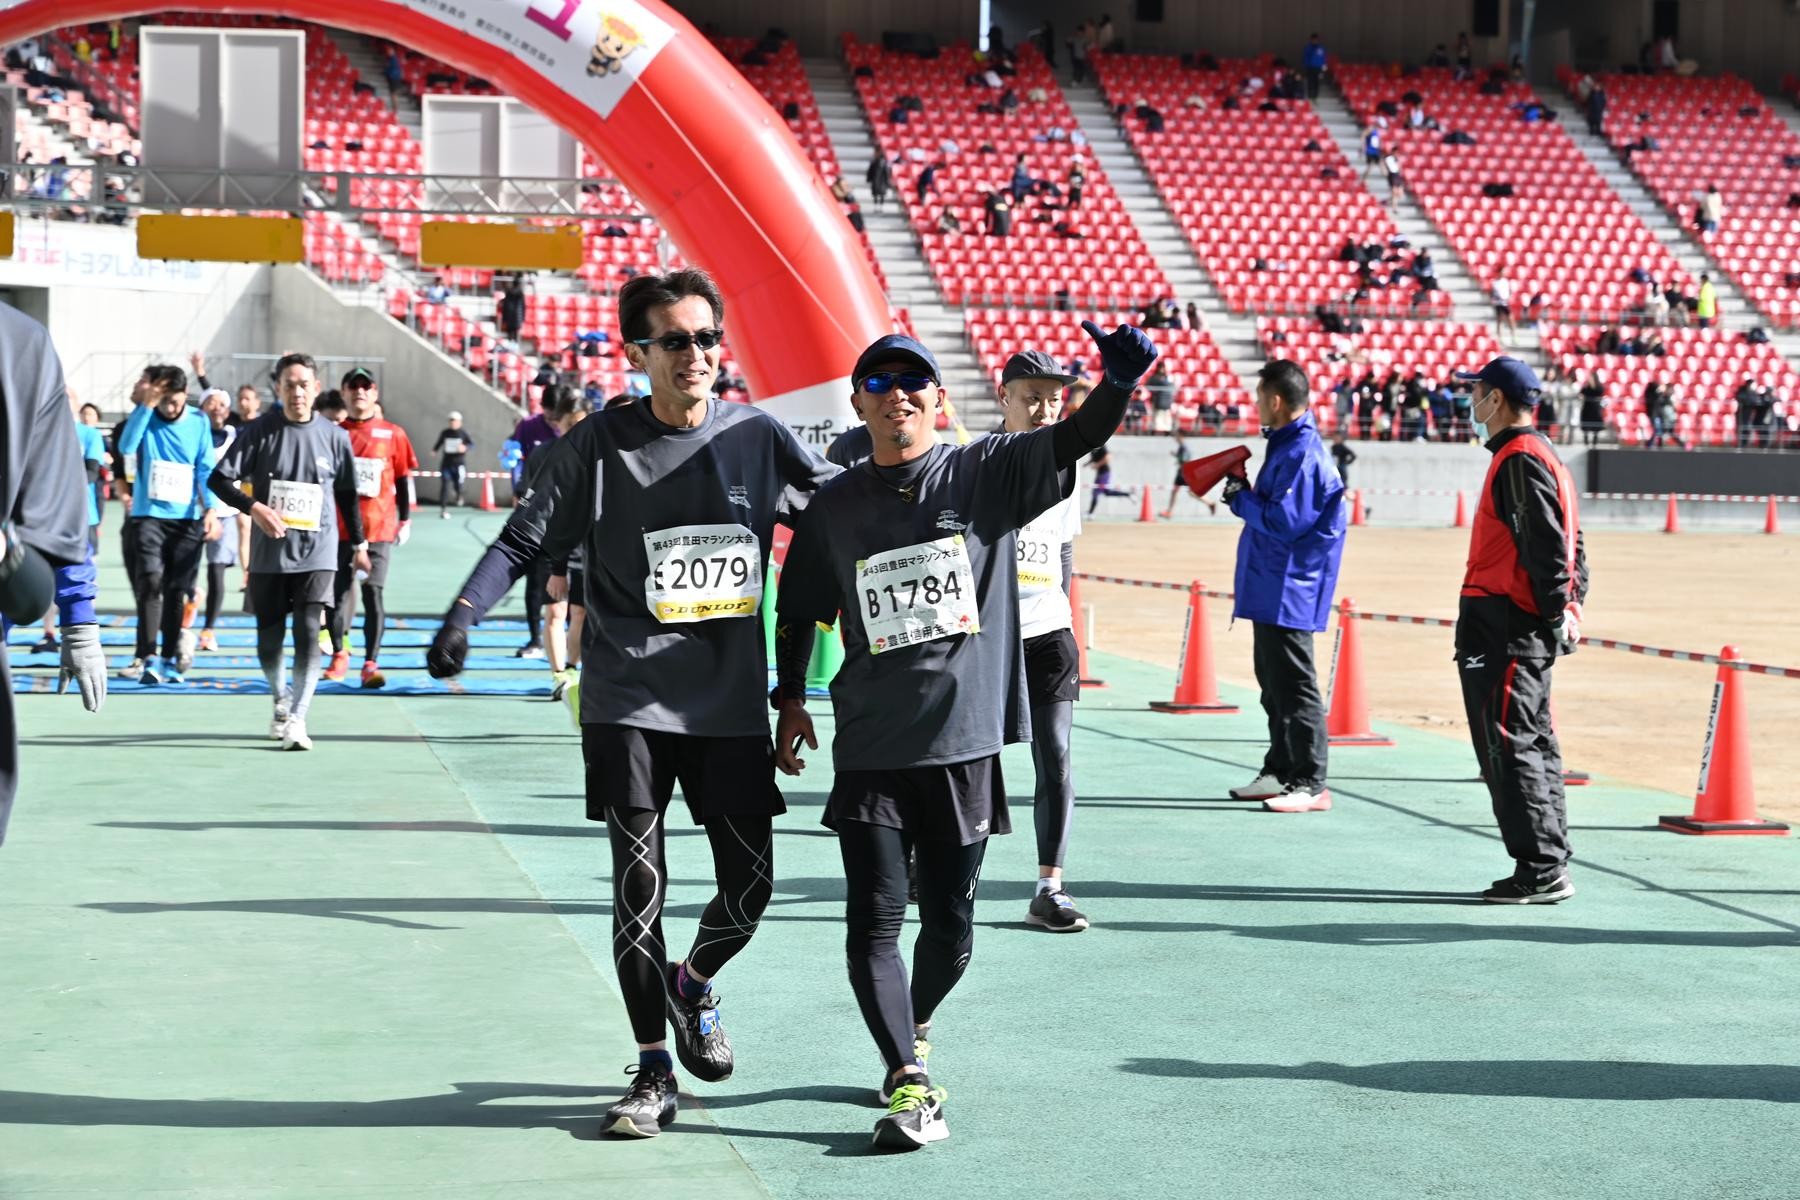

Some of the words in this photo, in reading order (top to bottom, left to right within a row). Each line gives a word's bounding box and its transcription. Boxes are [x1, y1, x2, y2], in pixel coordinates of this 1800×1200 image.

[677, 601, 749, 615] DUNLOP
[865, 570, 963, 619] B1784
[887, 621, 956, 648] 豊田信用金
